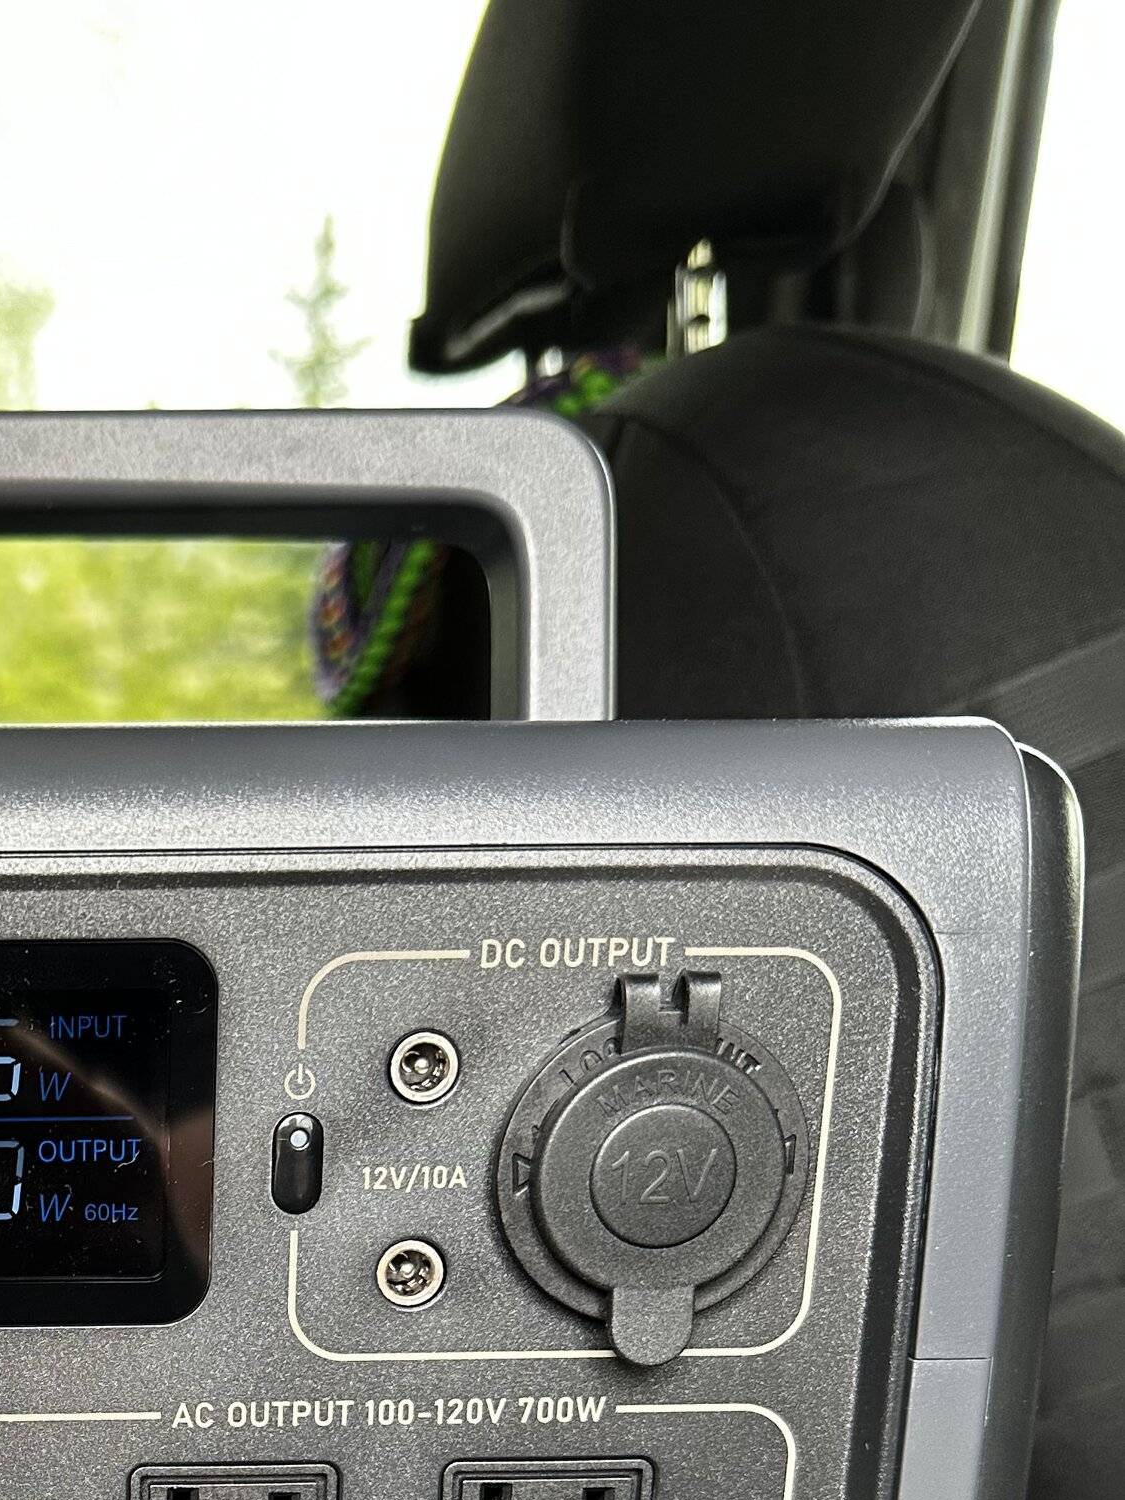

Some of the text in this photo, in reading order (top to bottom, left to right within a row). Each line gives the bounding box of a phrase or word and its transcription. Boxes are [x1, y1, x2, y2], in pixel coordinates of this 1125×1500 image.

[480, 937, 676, 969] DC OUTPUT
[49, 1015, 127, 1040] INPUT
[38, 1071, 72, 1102] W
[596, 1069, 741, 1118] MARINE
[38, 1138, 142, 1164] OUTPUT
[361, 1164, 467, 1192] 12V/10A
[611, 1148, 716, 1206] 12V
[38, 1193, 72, 1222] W
[84, 1202, 139, 1222] 60Hz
[172, 1396, 607, 1429] AC OUTPUT 100-120V 700W
